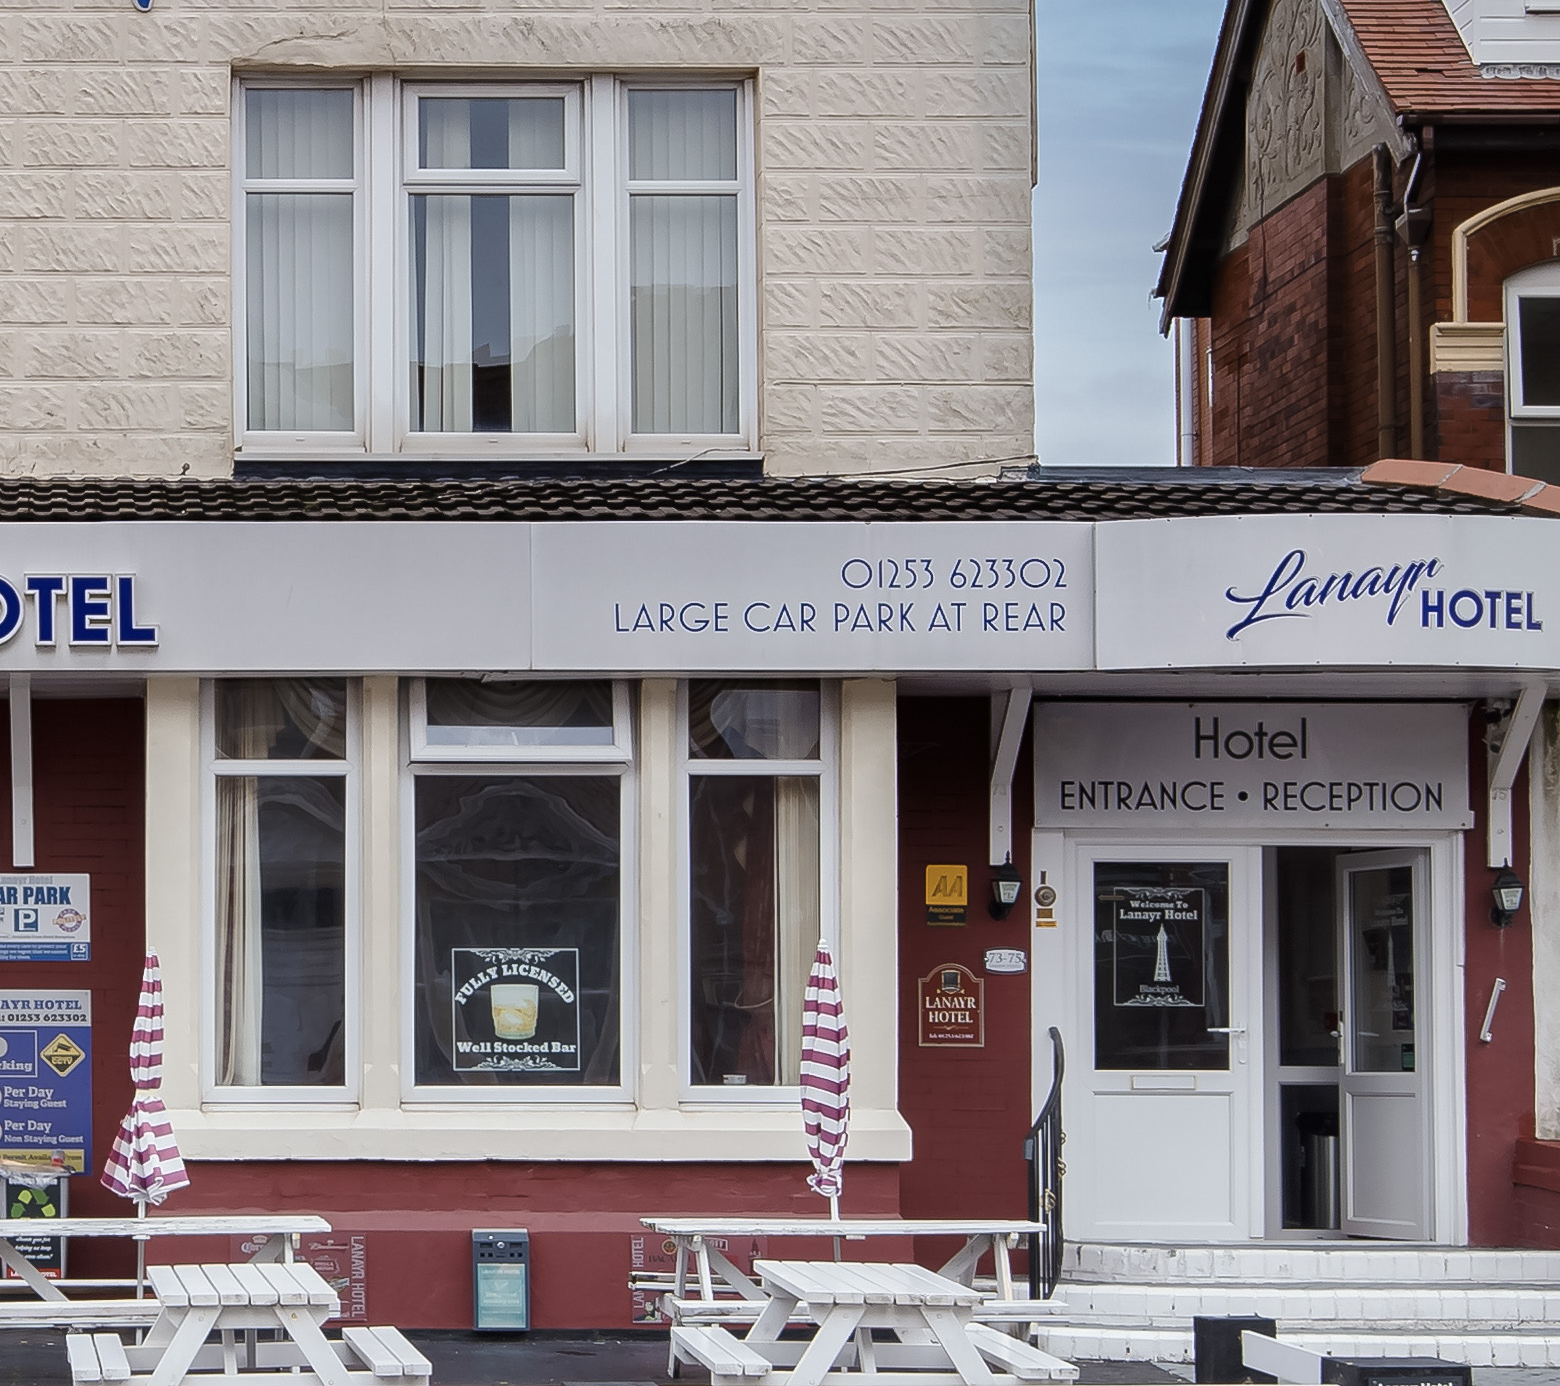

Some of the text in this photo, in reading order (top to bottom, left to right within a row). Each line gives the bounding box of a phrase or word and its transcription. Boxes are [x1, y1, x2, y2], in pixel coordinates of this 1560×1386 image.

[840, 558, 1067, 589] 01253 623302
[1226, 549, 1543, 641] Lanayr HOTEL
[615, 602, 1067, 633] LARGE CAR PARK AT REAR
[1194, 716, 1307, 760] Hotel
[1060, 781, 1443, 811] ENTRANCE RECEPTION
[931, 875, 963, 897] AA
[23, 886, 72, 905] PARK
[1130, 900, 1189, 909] Welcome To
[18, 909, 36, 931] P
[1120, 909, 1198, 923] Lanayr Hotel
[72, 944, 86, 953] £5
[989, 952, 1022, 963] 73-75
[454, 963, 574, 1005] FULLY LICENSED
[1140, 984, 1180, 994] Blackpool
[33, 999, 82, 1010] HOTEL
[925, 996, 976, 1009] LANAYR
[7, 1014, 40, 1022] 01253
[43, 1014, 87, 1022] 623302
[929, 1011, 973, 1023] HOTEL
[456, 1041, 576, 1053] Well Stocked Bar
[3, 1086, 26, 1097] Per
[28, 1086, 54, 1100] Day
[3, 1099, 67, 1109] Staying Guest
[4, 1120, 26, 1131] Per
[27, 1120, 52, 1133] Day
[4, 1135, 83, 1144] Non Staying Guest
[632, 1237, 645, 1269] HOTEL
[351, 1236, 366, 1318] LANAYR HOTEL
